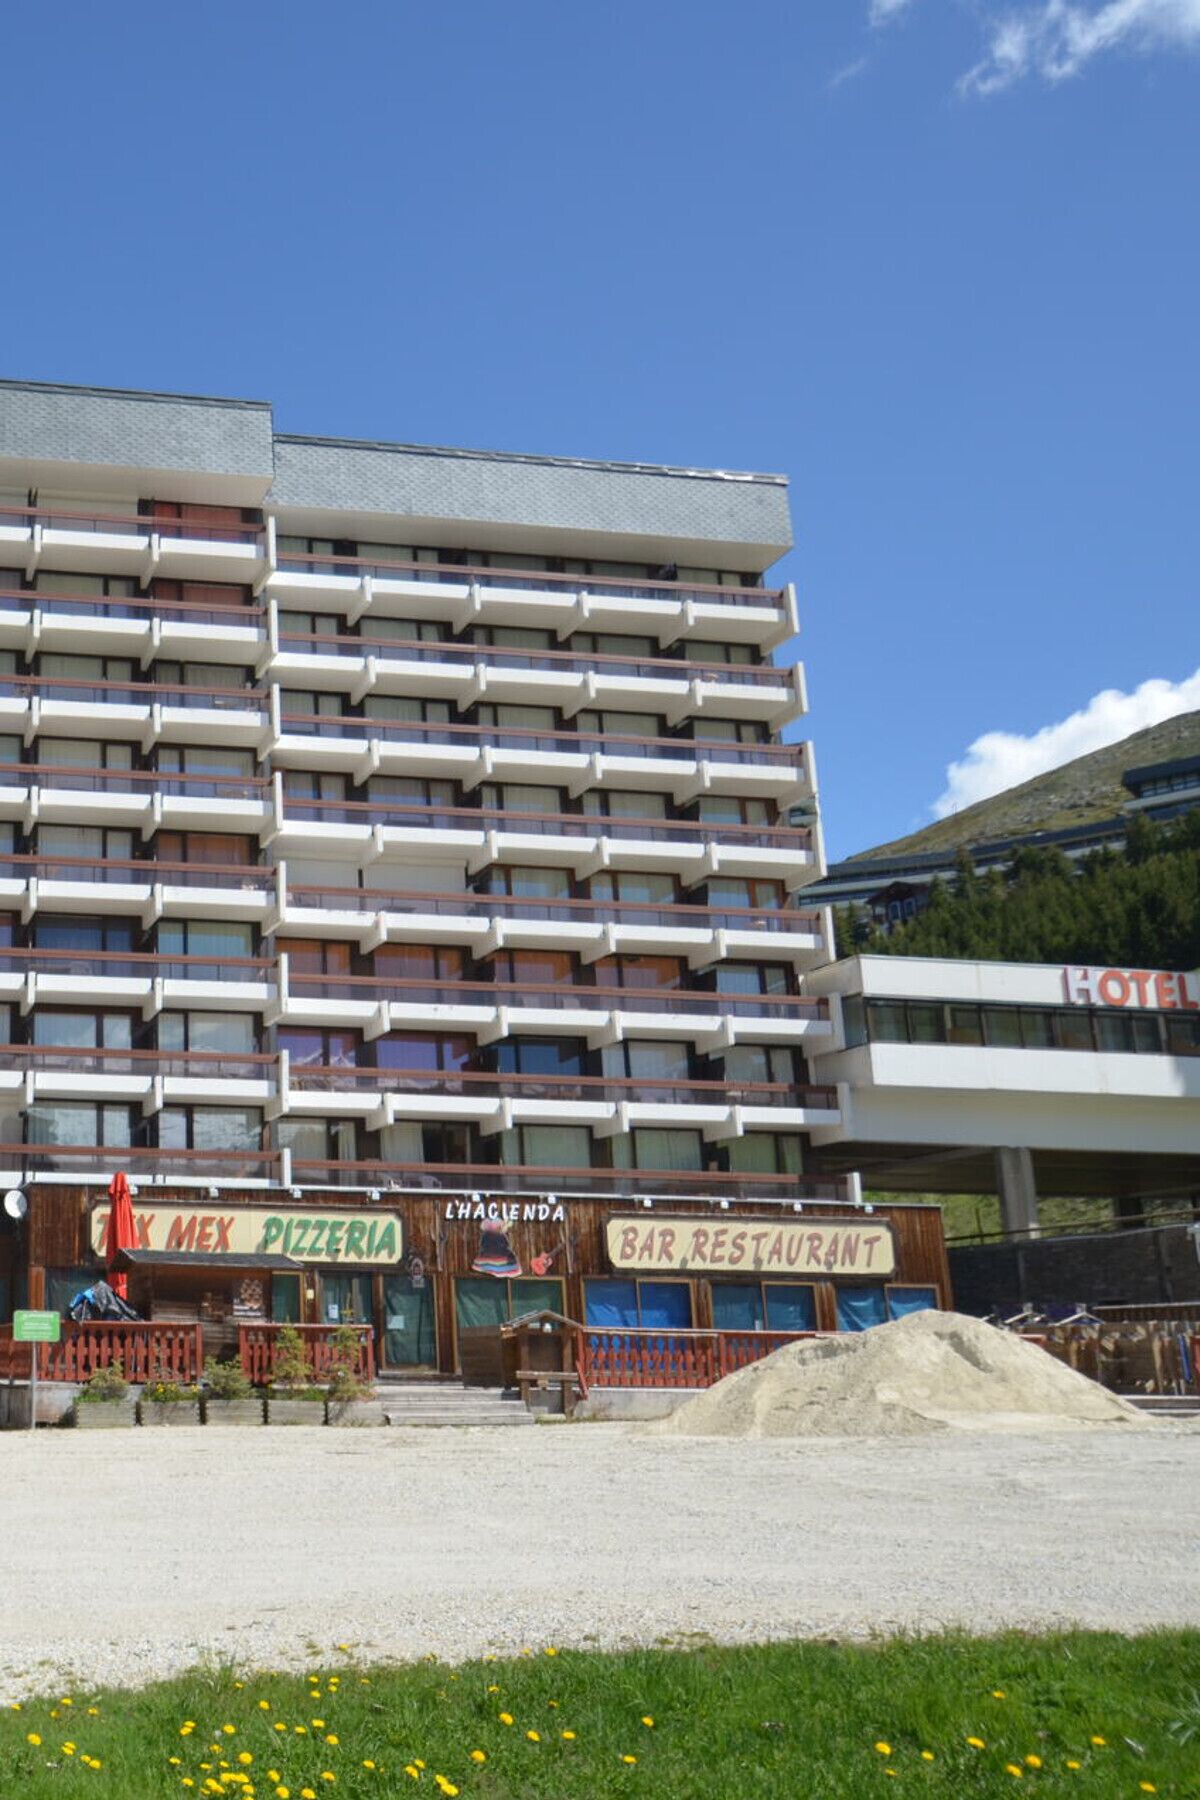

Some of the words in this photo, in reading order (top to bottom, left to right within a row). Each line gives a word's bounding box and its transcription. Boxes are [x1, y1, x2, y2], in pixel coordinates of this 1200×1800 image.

[1061, 967, 1198, 1008] HOTEL
[445, 1200, 565, 1221] L'HACIENDA
[95, 1213, 156, 1247] TX
[165, 1215, 235, 1251] MEX
[261, 1217, 397, 1260] PIZZERIA
[619, 1226, 676, 1262] BAR
[691, 1228, 882, 1267] RESTAURANT
